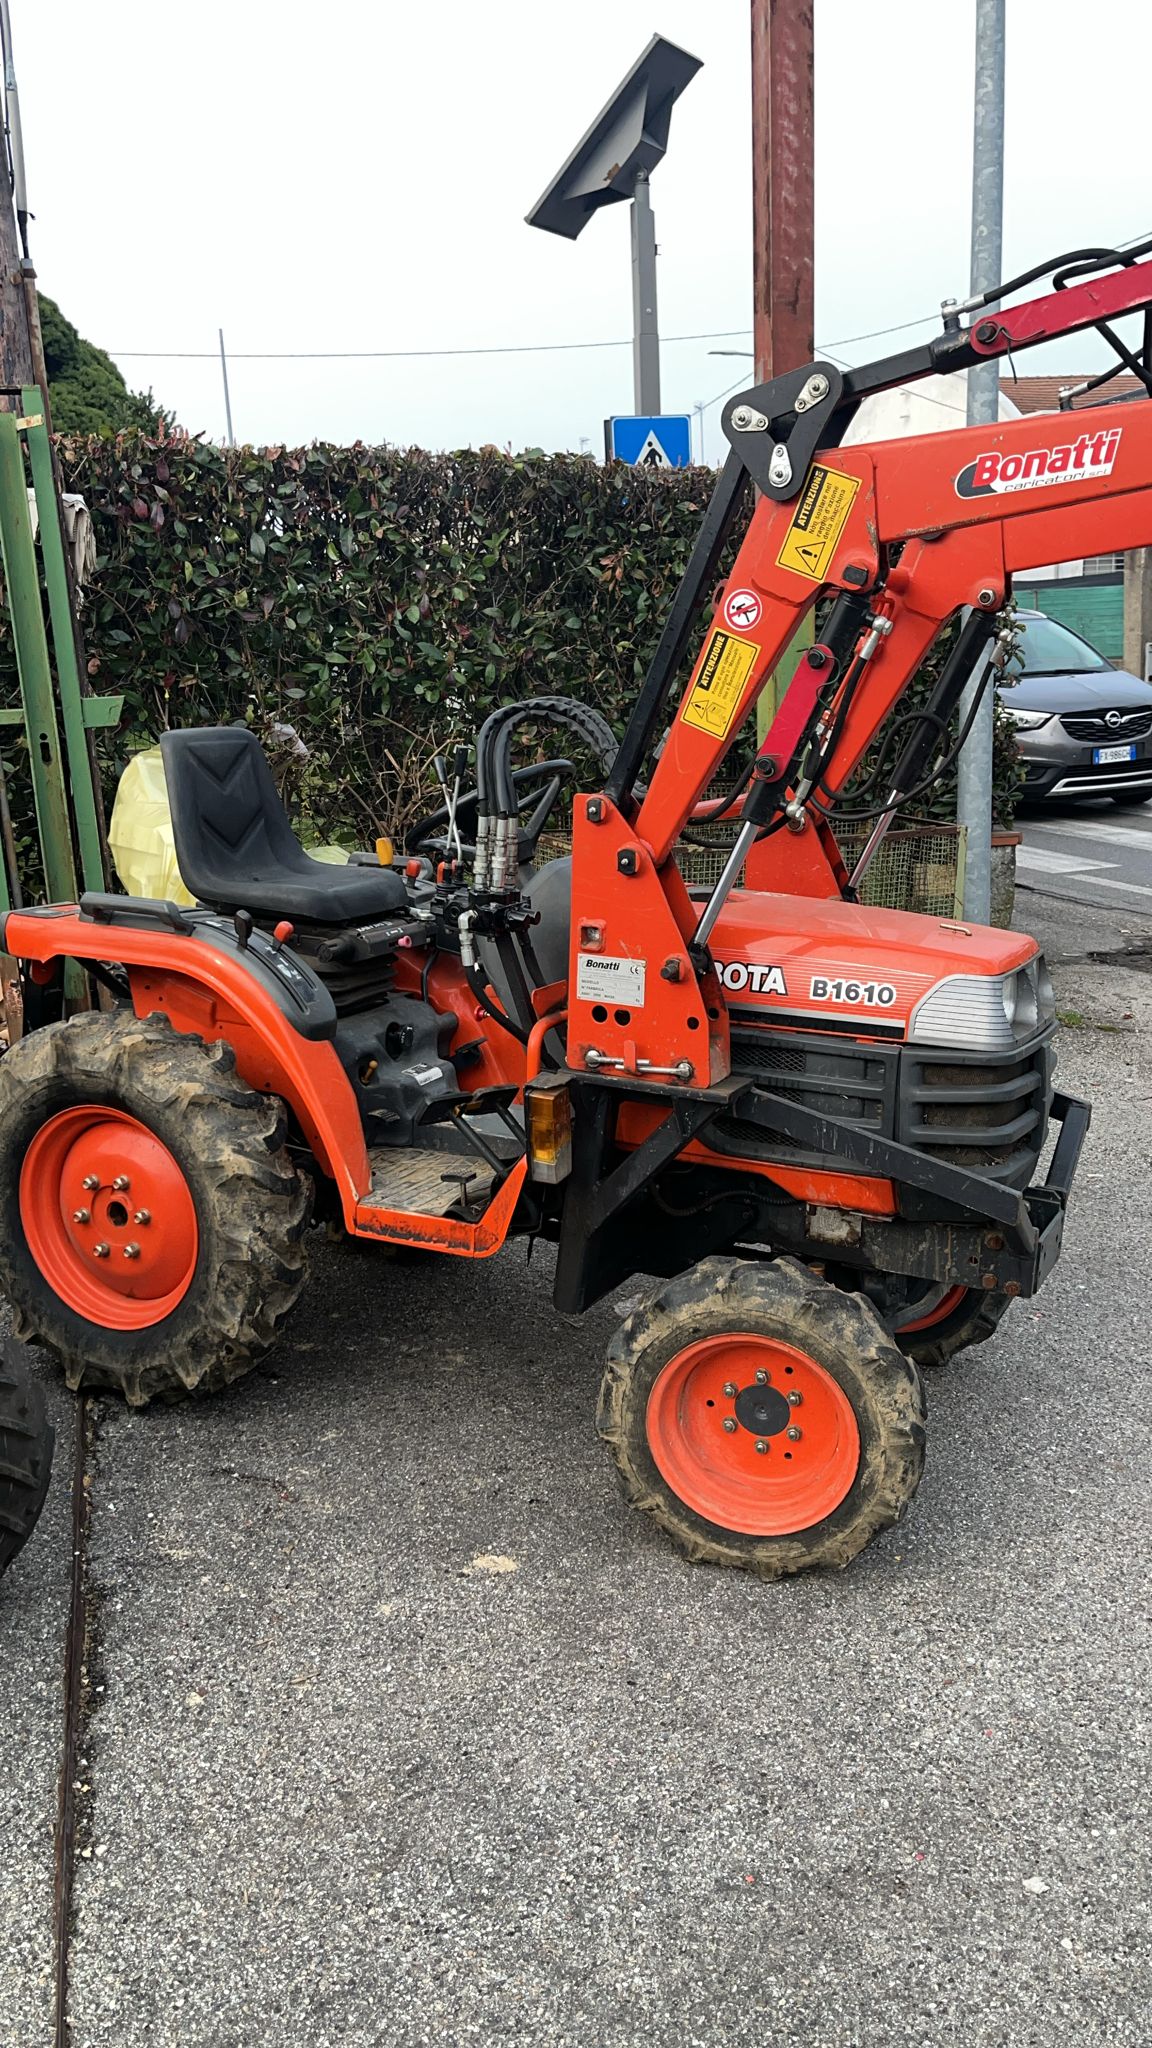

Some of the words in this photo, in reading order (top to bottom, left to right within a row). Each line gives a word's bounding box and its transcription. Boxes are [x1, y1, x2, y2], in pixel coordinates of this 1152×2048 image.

[972, 428, 1122, 488] Bonatti
[1004, 470, 1086, 492] caricatori
[797, 469, 824, 526] ATTENZIONE
[808, 520, 818, 534] Non
[814, 494, 828, 519] sostare
[823, 482, 832, 493] nel
[822, 522, 833, 539] della
[828, 488, 846, 522] macchina
[815, 515, 828, 537] raggio
[701, 634, 725, 686] ATTENZIONE
[586, 959, 620, 970] Bonatti
[811, 977, 895, 1006] B1610
